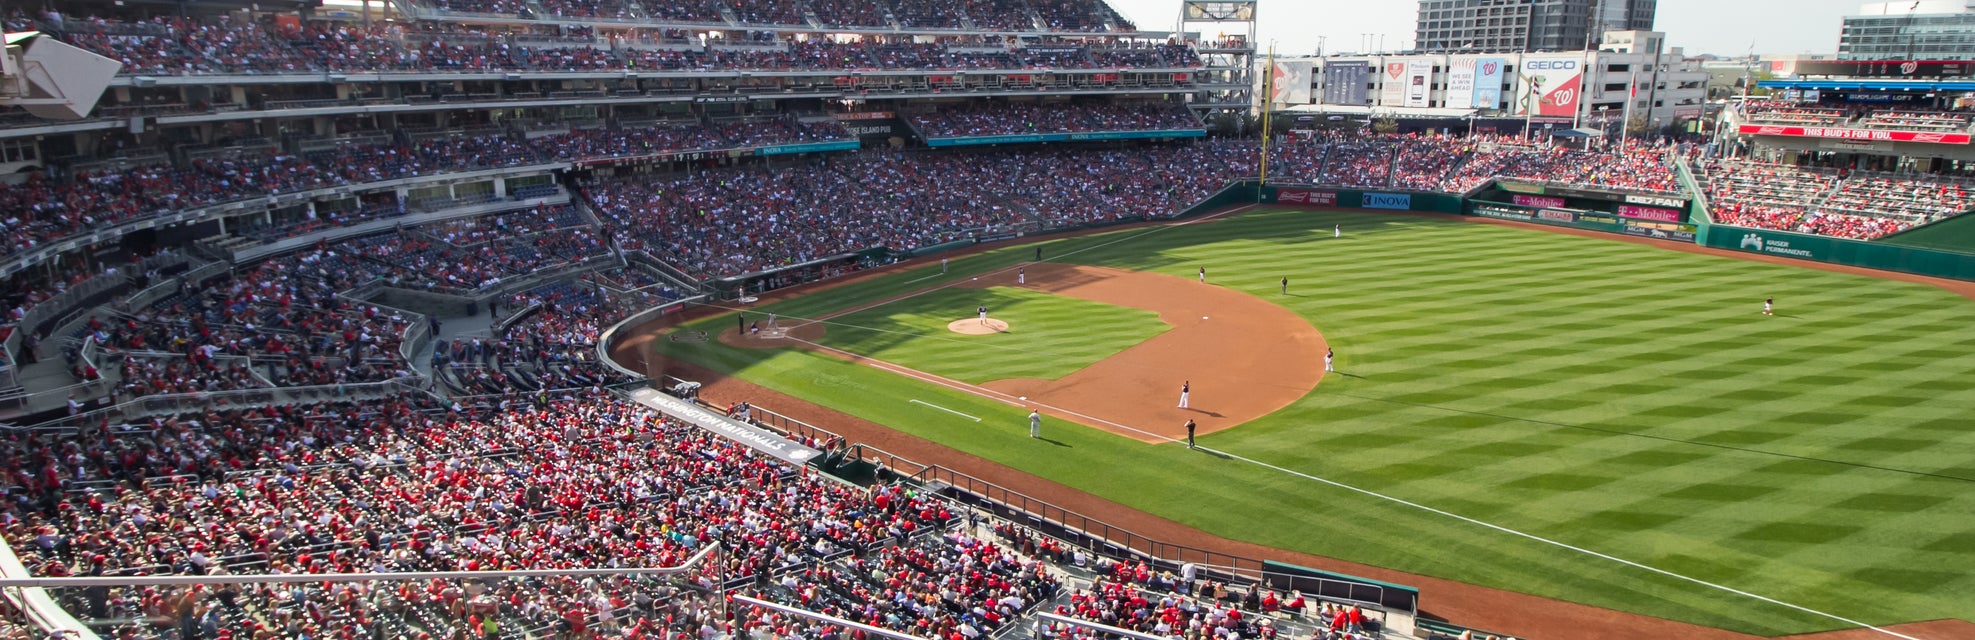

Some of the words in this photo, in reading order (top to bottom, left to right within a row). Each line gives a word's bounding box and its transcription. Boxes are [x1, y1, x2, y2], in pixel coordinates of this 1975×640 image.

[1527, 61, 1576, 70] GEICO
[862, 126, 880, 134] ISLAND
[881, 125, 891, 133] PUB
[1803, 128, 1822, 136] THIS
[1824, 129, 1850, 137] BUD'S
[1851, 130, 1870, 138] FOR
[1871, 131, 1893, 139] YOU.
[1374, 195, 1409, 206] INOVA
[1655, 198, 1684, 208] FAN
[651, 395, 718, 427] WASHINGTON
[716, 421, 787, 451] NATIONALS
